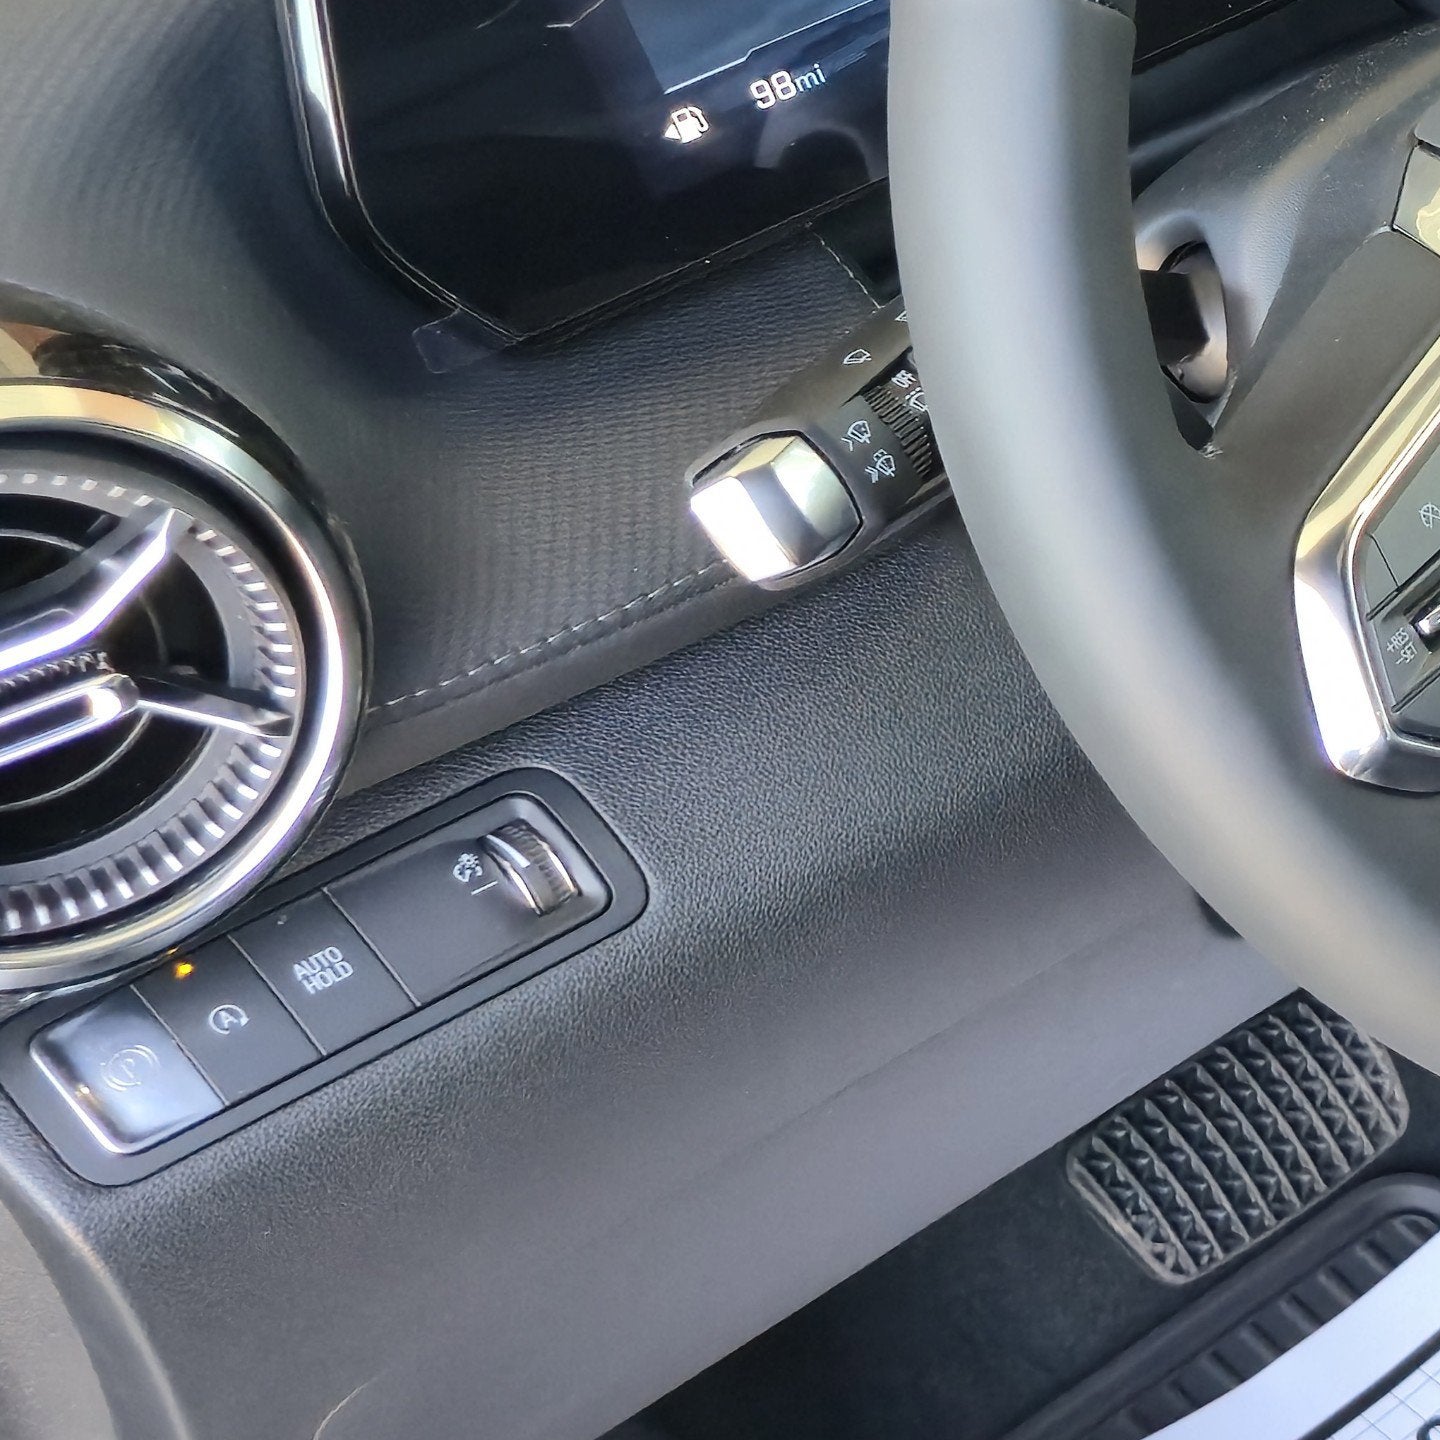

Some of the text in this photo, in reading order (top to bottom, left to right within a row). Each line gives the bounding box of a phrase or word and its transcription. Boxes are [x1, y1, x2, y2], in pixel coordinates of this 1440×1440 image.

[749, 62, 826, 110] 98mi
[1387, 628, 1409, 652] +RES
[293, 946, 344, 981] AUTO
[301, 960, 354, 994] HOLD
